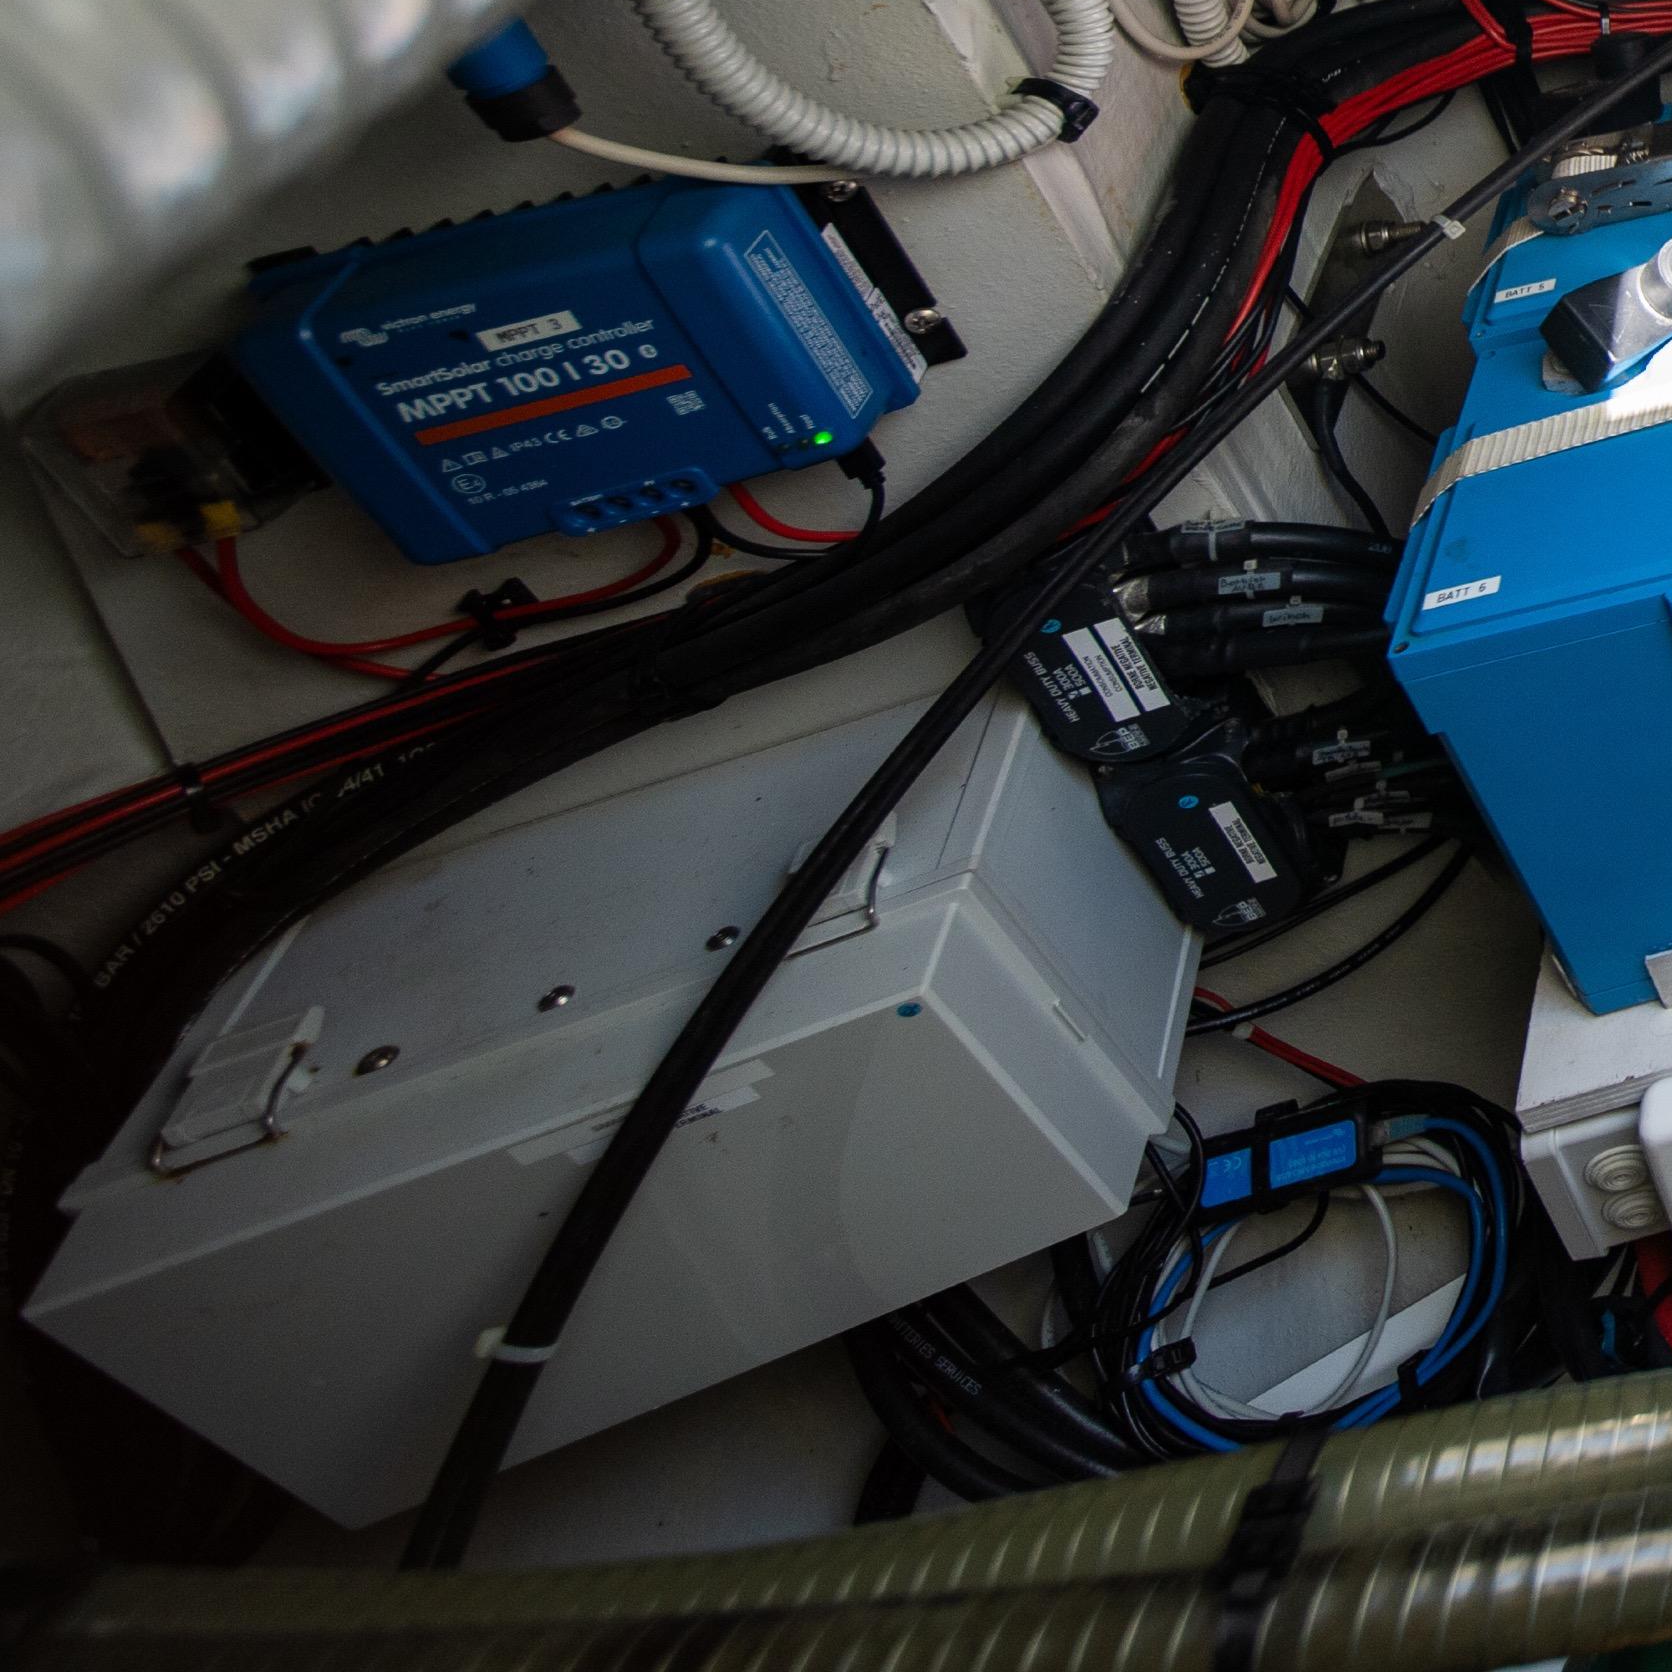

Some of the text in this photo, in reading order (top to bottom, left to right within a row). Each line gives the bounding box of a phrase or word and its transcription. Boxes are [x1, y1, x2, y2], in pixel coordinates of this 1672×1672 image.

[1504, 284, 1536, 299] BATT
[430, 303, 477, 320] energy
[496, 318, 564, 343] MPPT 3
[375, 319, 655, 396] SmartSolar charge controller
[397, 348, 631, 423] MPPT 100 30
[544, 428, 573, 445] CE
[1436, 581, 1487, 604] BATT 6
[1120, 636, 1143, 664] TERMINAL
[1024, 651, 1080, 723] HEAVY DUTY BUSS
[1052, 667, 1072, 691] 300A
[1064, 663, 1083, 687] 500A
[1118, 727, 1141, 750] BEP
[1155, 837, 1176, 859] BUSS
[1170, 858, 1190, 877] DUTY
[94, 809, 299, 989] BAR 2610 PSI MSHA
